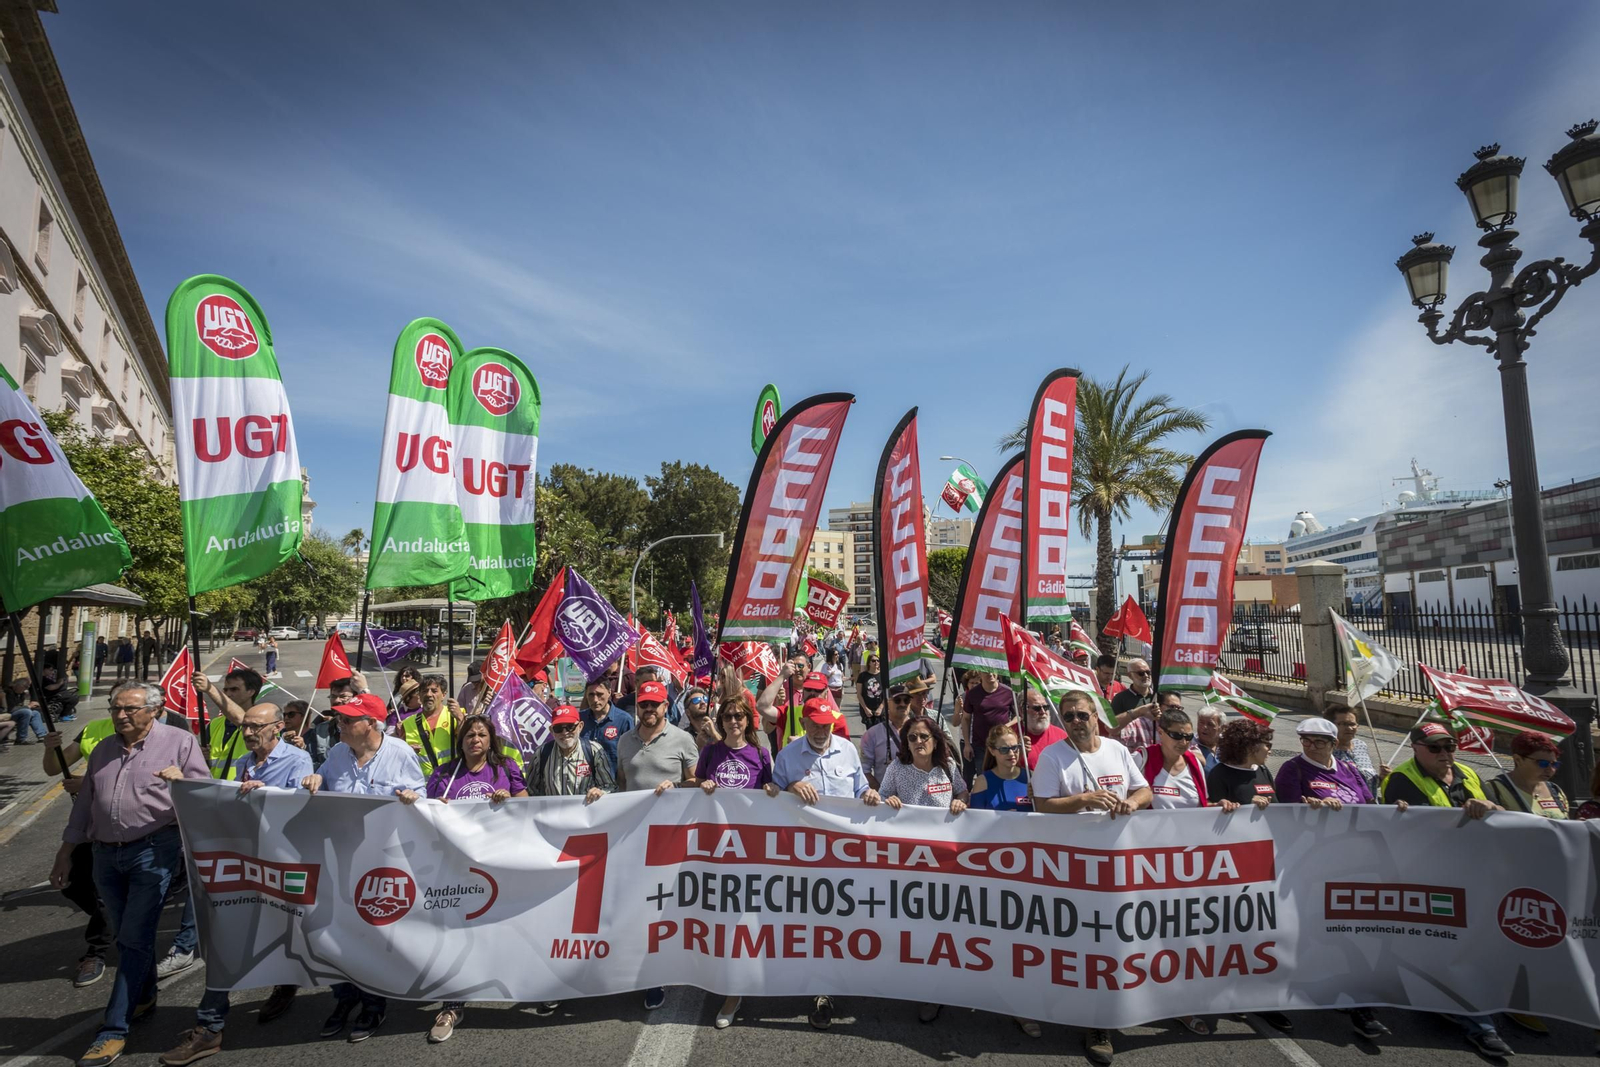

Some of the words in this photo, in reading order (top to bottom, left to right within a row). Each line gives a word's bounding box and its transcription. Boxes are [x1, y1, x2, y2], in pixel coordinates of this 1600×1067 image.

[204, 304, 250, 333] UGT
[422, 340, 450, 363] UGT
[480, 370, 514, 391] UGT
[193, 413, 288, 463] UGT
[396, 431, 455, 478] UG
[463, 457, 531, 498] UGT
[1038, 397, 1069, 575] CCOO
[747, 423, 831, 600] CCOO
[205, 516, 300, 554] Andalucía
[382, 536, 471, 553] Andalucía
[891, 453, 924, 635] CCOO
[17, 532, 118, 567] Andaluc
[469, 554, 534, 570] Andalucía
[1175, 465, 1242, 646] CCOO
[1038, 579, 1066, 594] Cádiz
[564, 600, 606, 638] UGT
[742, 603, 780, 617] Cádiz
[807, 605, 835, 622] Cádiz
[897, 632, 924, 652] Cádi
[970, 632, 1004, 650] Cádiz
[1175, 648, 1218, 666] Cádiz
[514, 701, 552, 746] UGT
[686, 828, 748, 858] LA
[764, 831, 940, 868] LUCHA
[956, 845, 1241, 887] CONTINÚA
[361, 876, 410, 899] UGT
[556, 832, 609, 934] 1
[212, 895, 268, 908] provincial
[269, 901, 280, 909] de
[423, 897, 461, 910] CÁDIZ
[1330, 889, 1428, 915] CCOO
[1504, 896, 1558, 922] UGT
[1326, 924, 1352, 933] unión
[1354, 925, 1405, 935] provincial
[1408, 927, 1421, 936] de
[1424, 928, 1458, 940] Cádiz
[550, 938, 610, 960] MAYO
[647, 918, 882, 961] PRIMERO
[899, 930, 994, 972] LAS
[1011, 941, 1279, 991] PERSONAS
